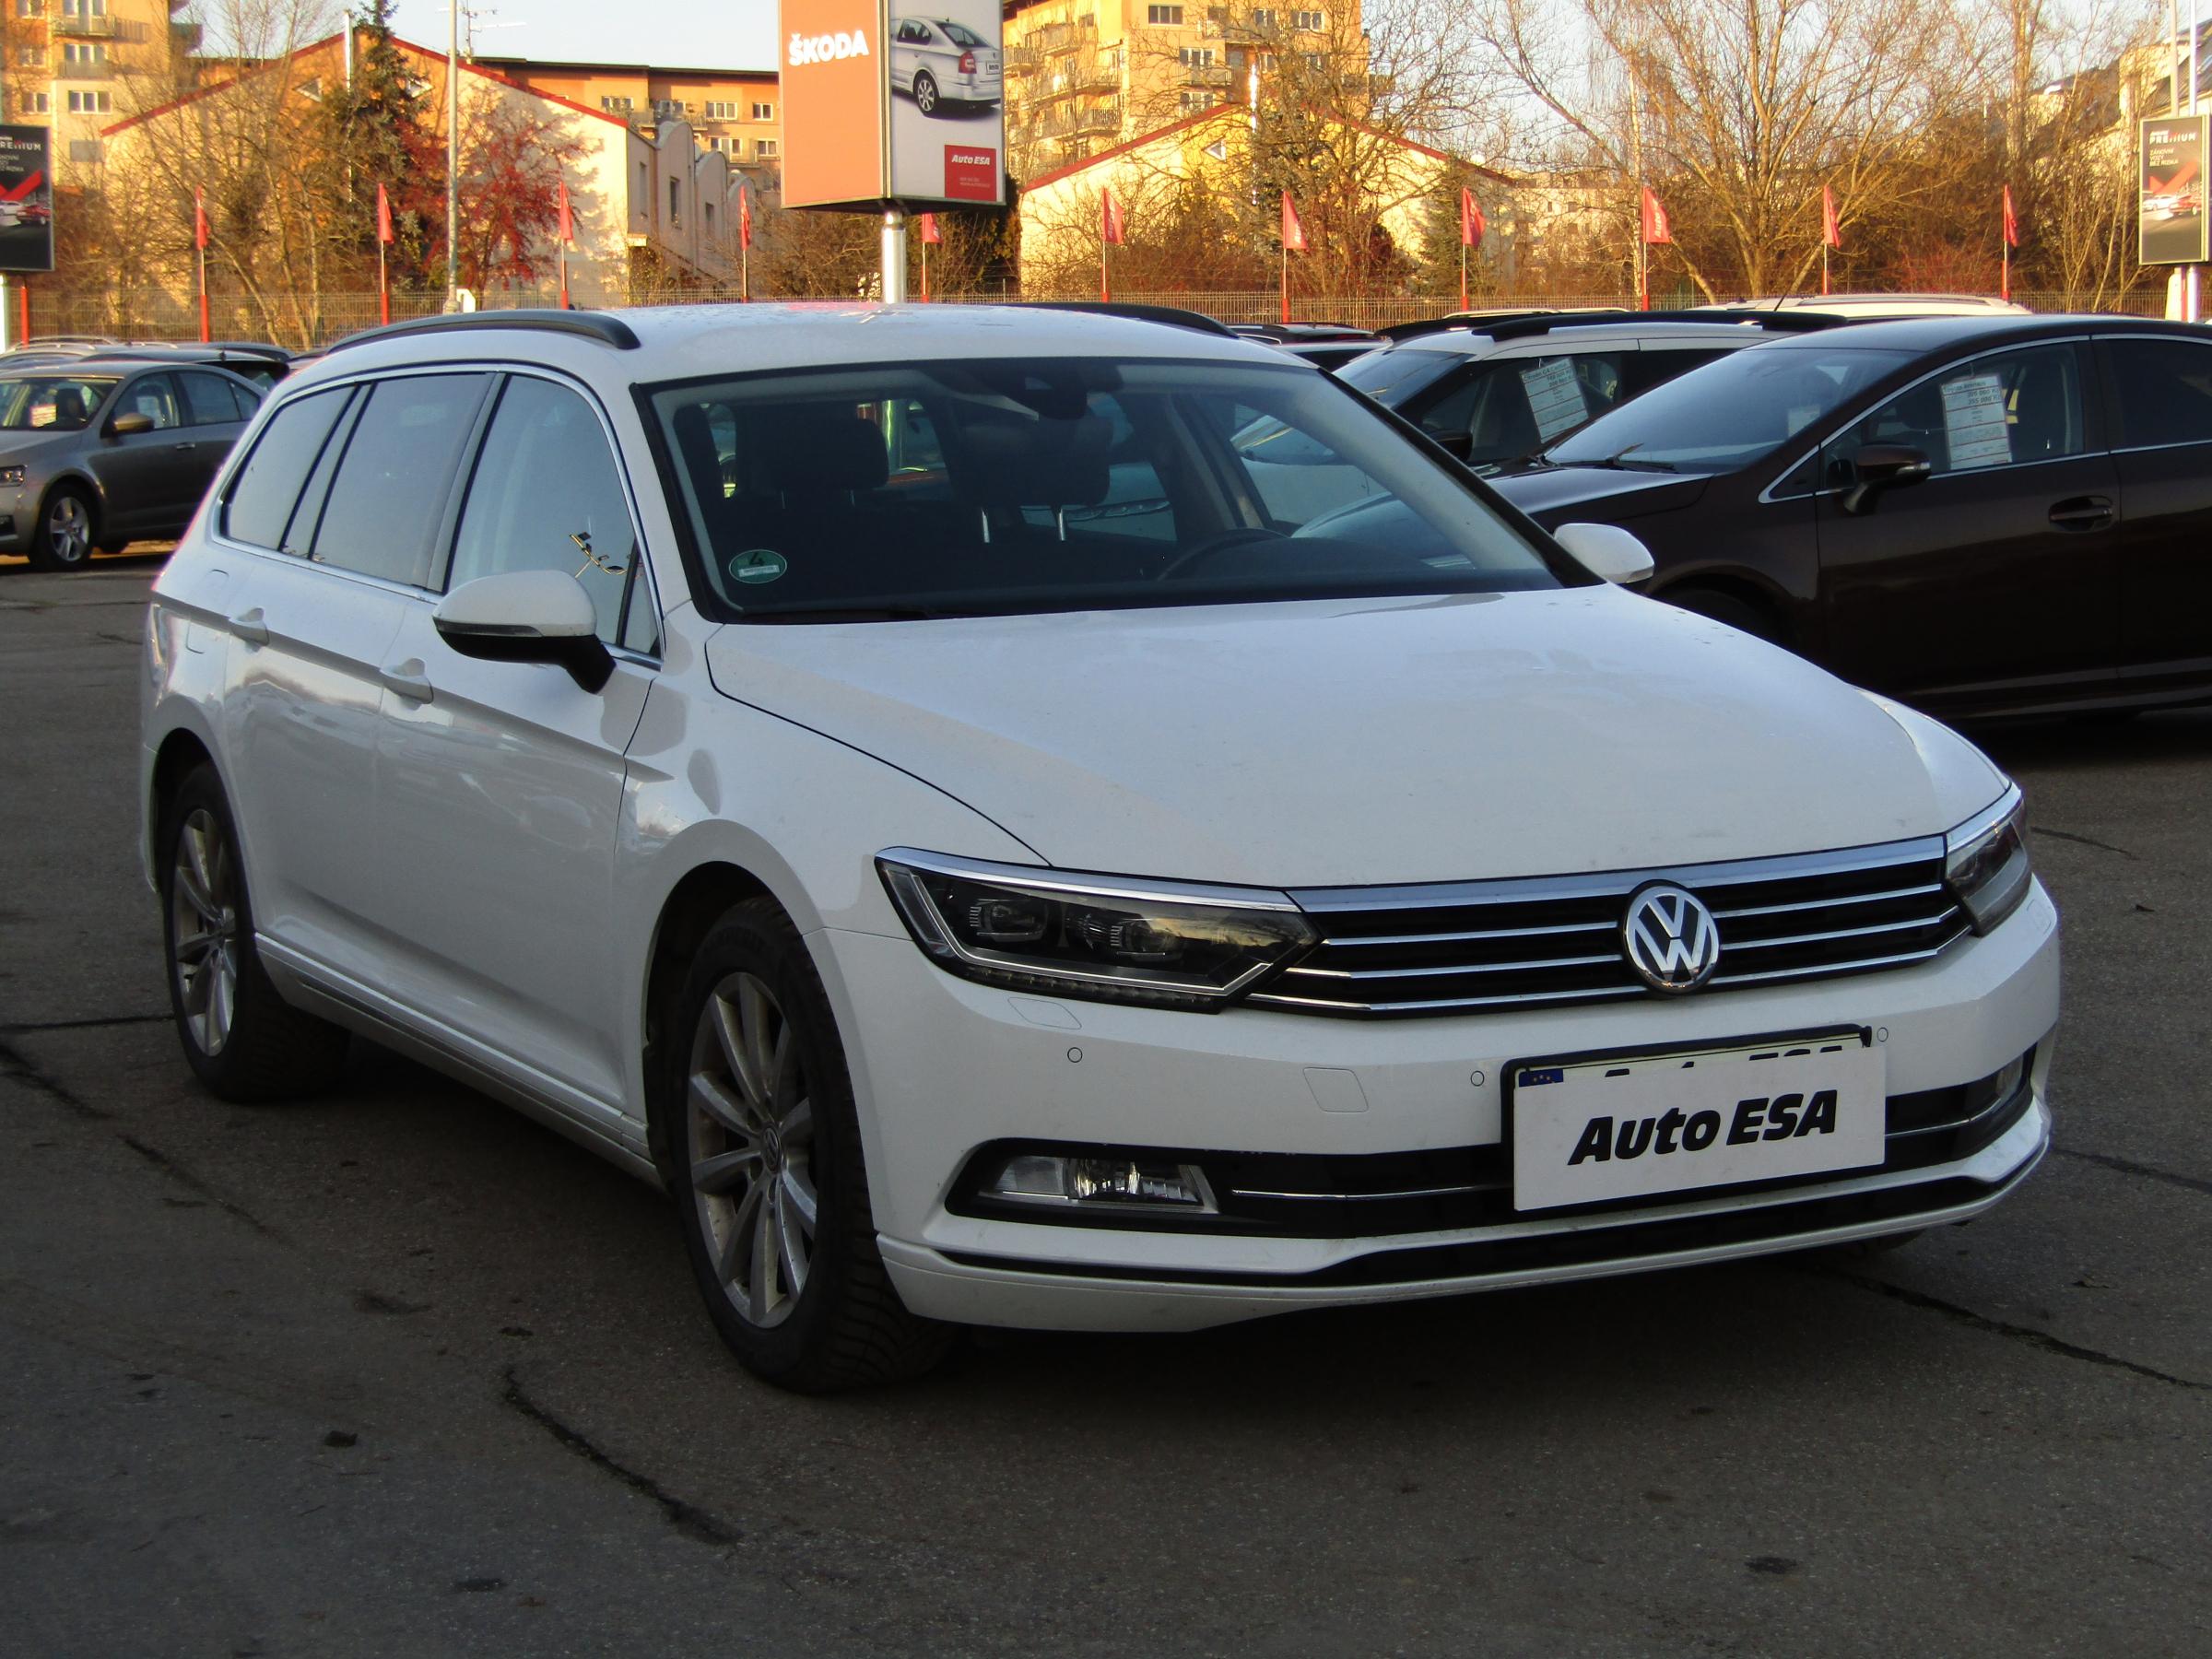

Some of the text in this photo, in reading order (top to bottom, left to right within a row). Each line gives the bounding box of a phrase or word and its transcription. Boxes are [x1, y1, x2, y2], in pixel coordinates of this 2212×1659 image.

[789, 29, 870, 66] ŠKODA
[951, 154, 991, 165] Auto ESA
[1568, 1089, 1838, 1166] Auto ESA
